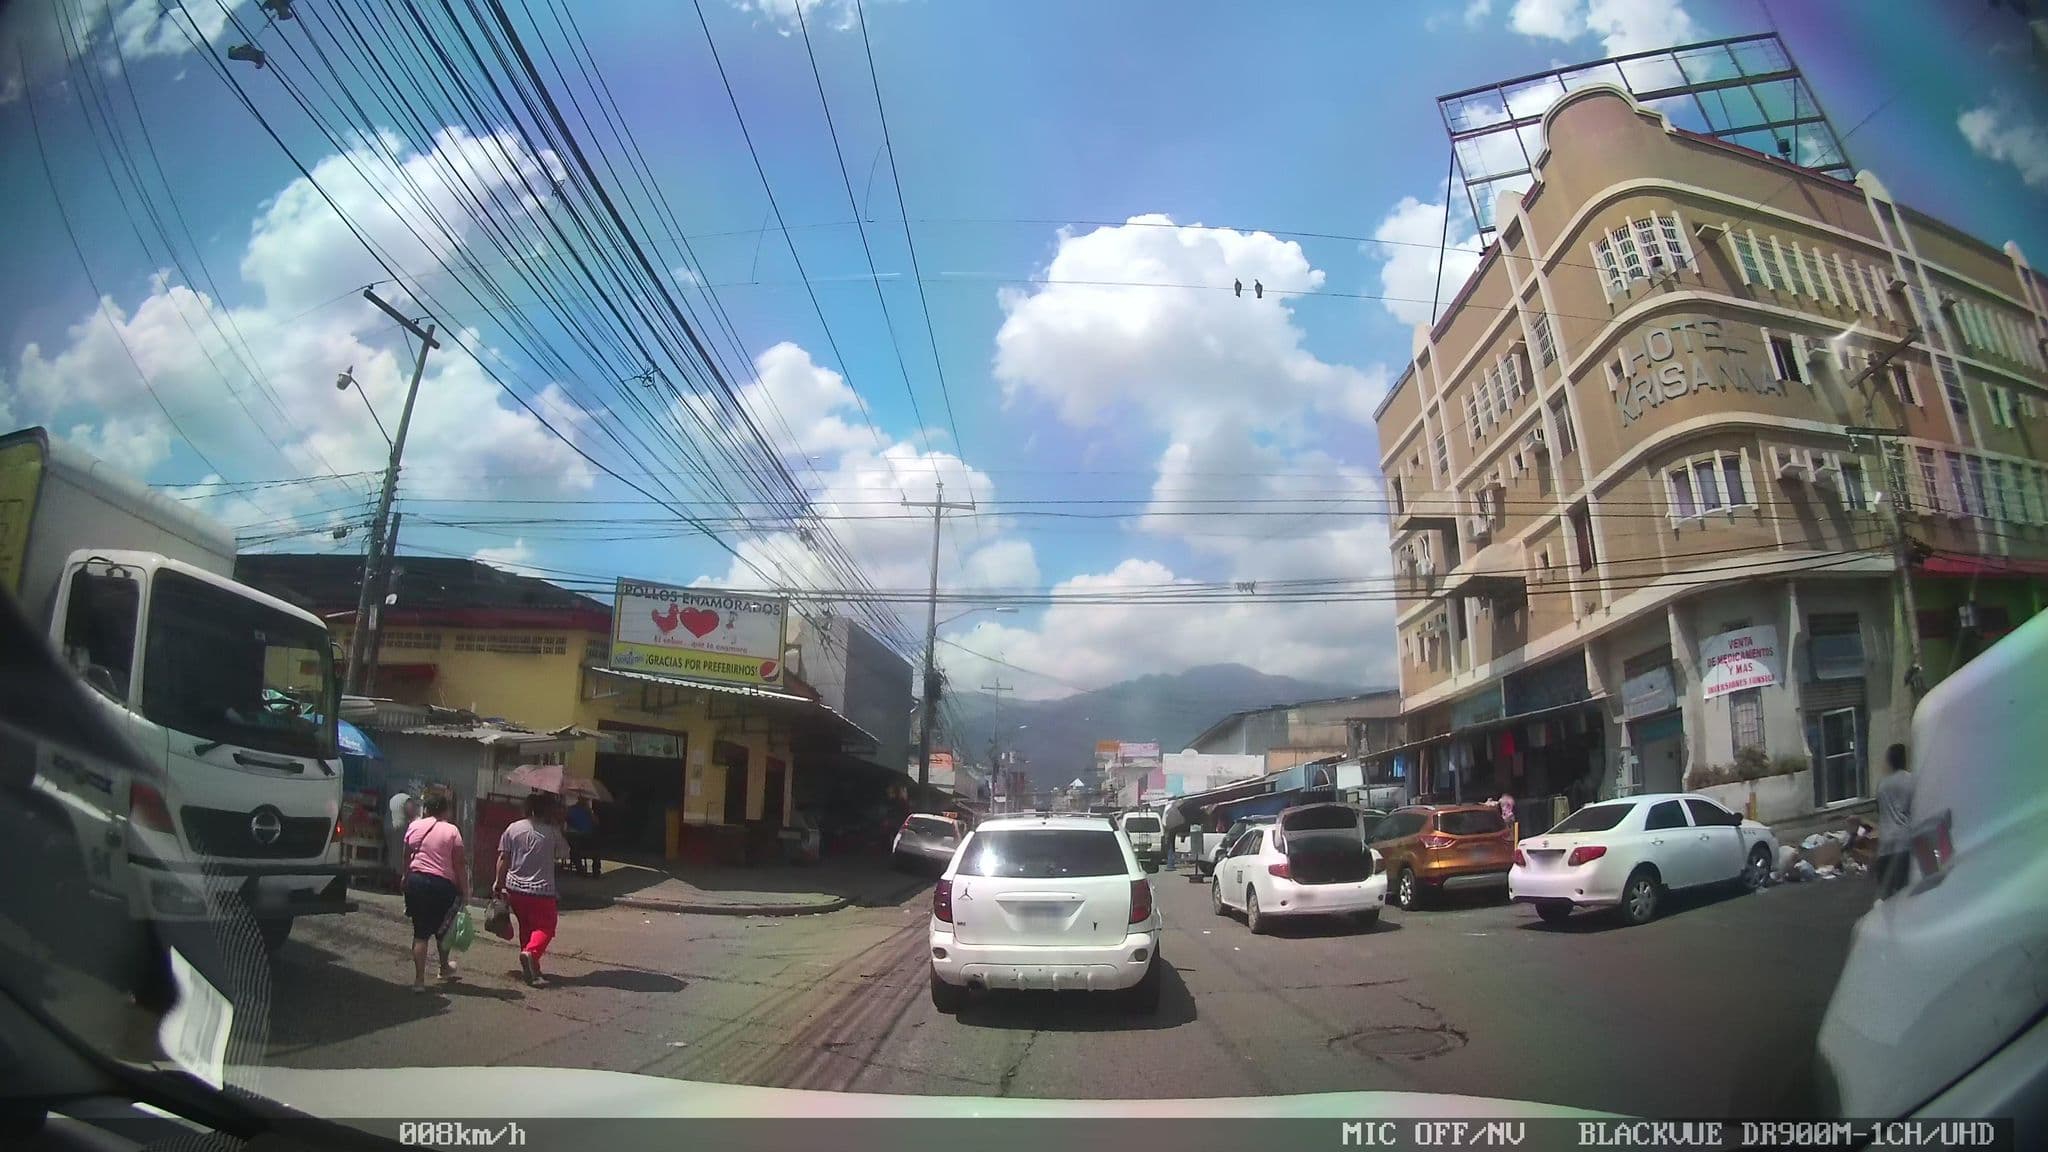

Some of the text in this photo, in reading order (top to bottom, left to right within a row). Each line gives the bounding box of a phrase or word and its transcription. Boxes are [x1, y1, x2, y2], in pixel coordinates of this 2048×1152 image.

[1624, 320, 1747, 378] HOTEL
[1616, 358, 1784, 428] KRISANNA
[624, 583, 781, 616] POLLOS ENAMORADOS
[1728, 636, 1753, 649] VENTA
[684, 658, 701, 671] POR
[1707, 646, 1774, 668] DE MEDICAMENTOS
[1726, 662, 1753, 675] Y MAS
